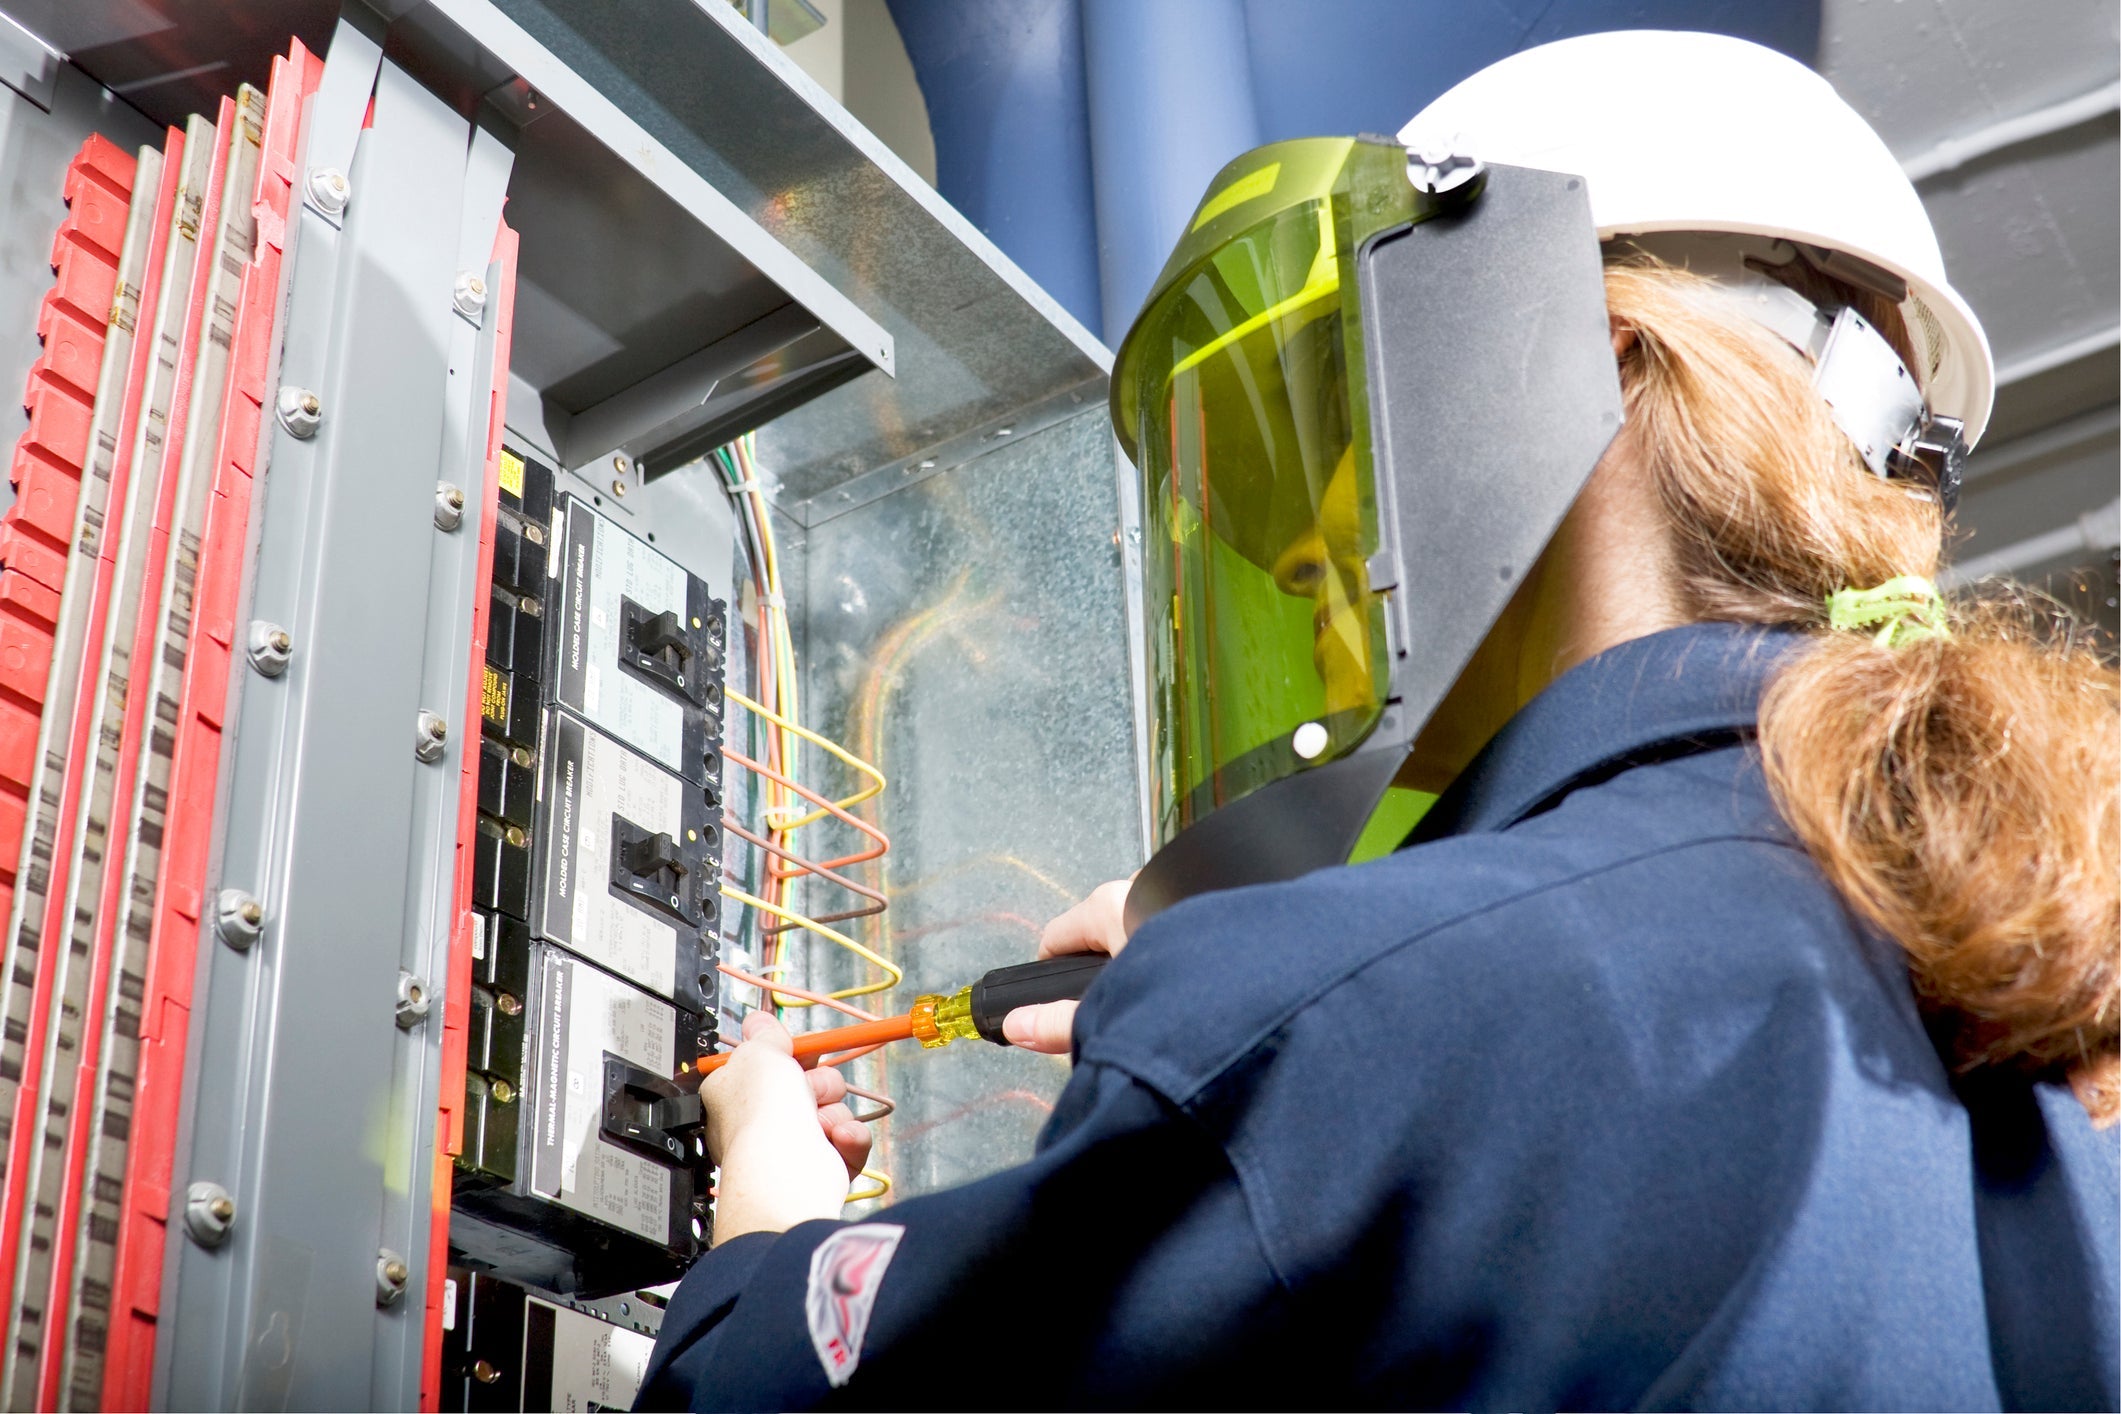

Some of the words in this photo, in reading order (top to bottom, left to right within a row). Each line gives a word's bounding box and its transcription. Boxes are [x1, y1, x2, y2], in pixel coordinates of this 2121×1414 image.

[577, 544, 586, 578] BREAKER
[575, 578, 583, 610] CIRCUIT
[571, 635, 580, 670] MOLDED
[486, 706, 490, 715] DO
[565, 760, 574, 797] BREAKER
[586, 730, 597, 798] MODIFICATIONS
[563, 798, 572, 831] CIRCUIT
[561, 833, 570, 857] CASE
[708, 856, 720, 867] C
[559, 860, 568, 898] MOLDED
[707, 930, 719, 940] B
[554, 971, 564, 1012] BREAKER
[705, 1005, 716, 1015] A
[552, 1013, 561, 1049] CIRCUIT
[697, 1036, 708, 1047] C
[547, 1047, 560, 1146] THERMAL-MAGNETIC
[693, 1202, 704, 1212] A
